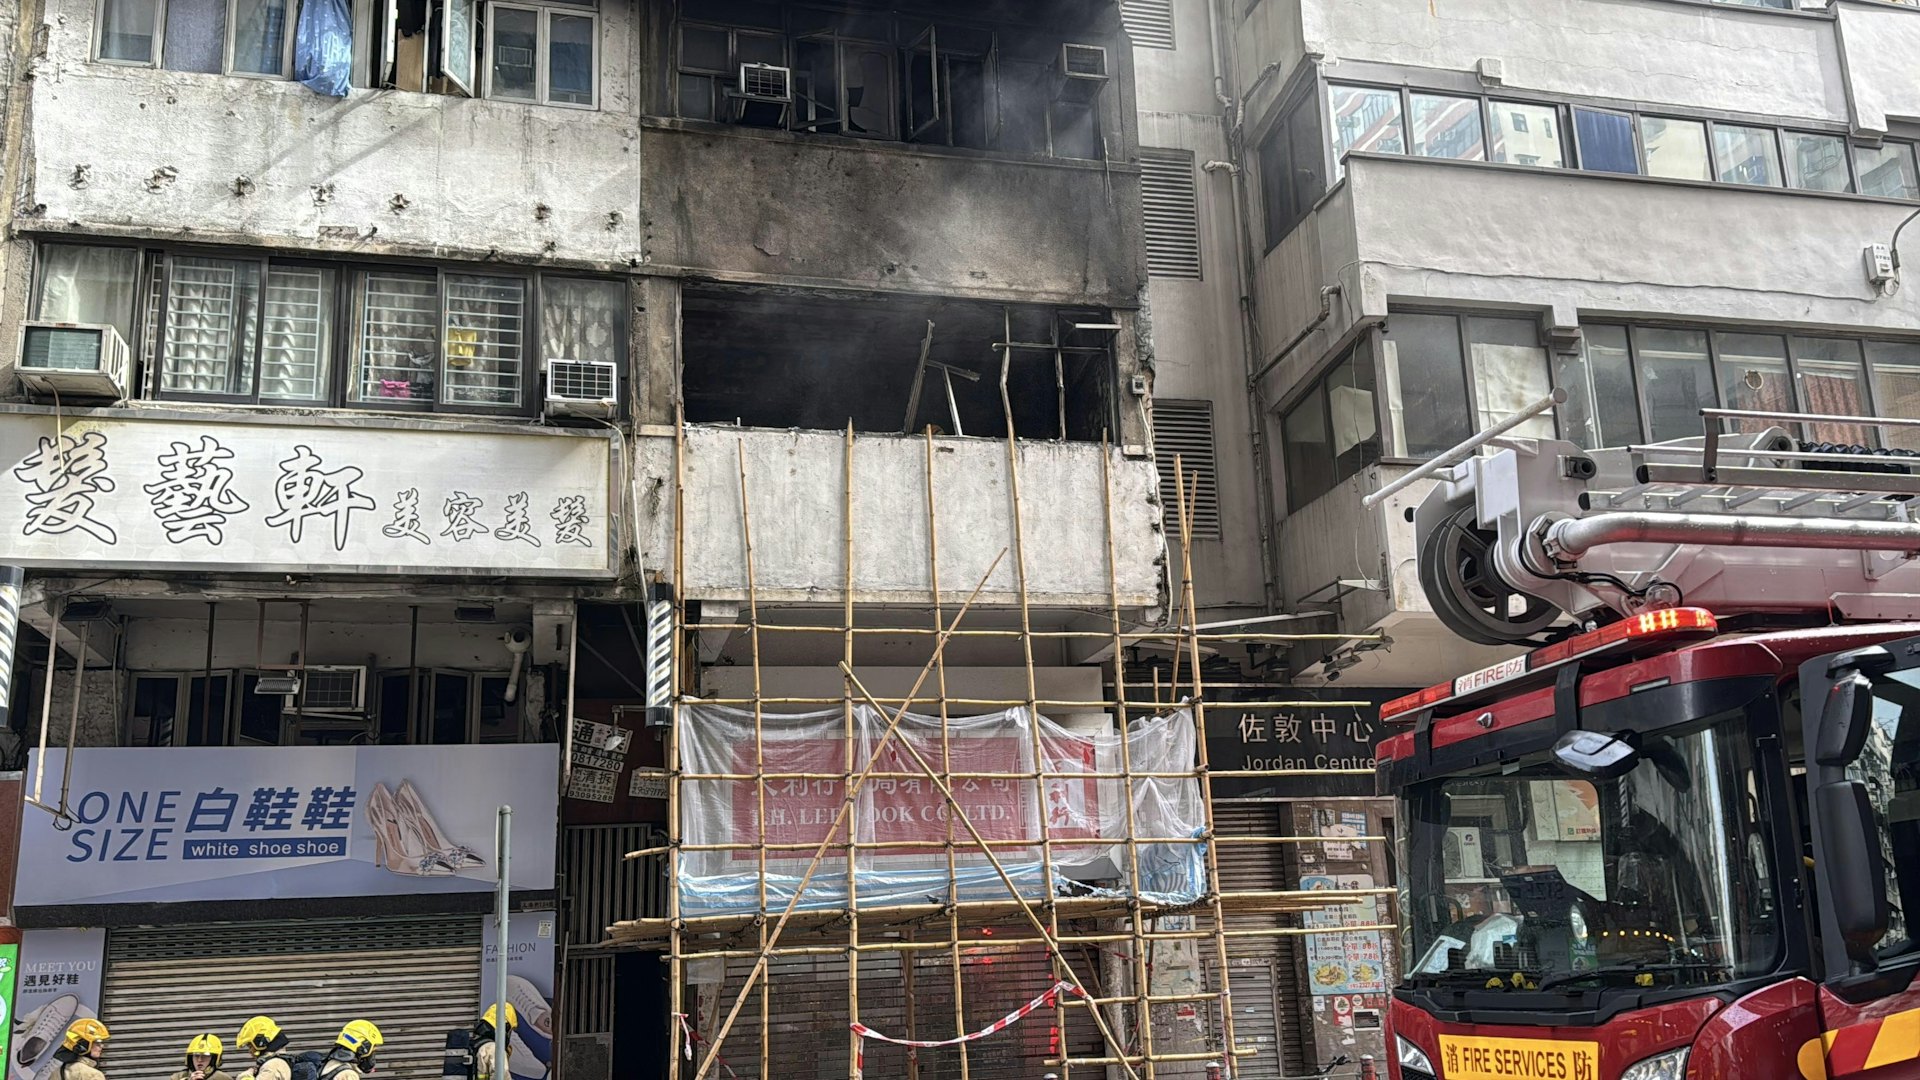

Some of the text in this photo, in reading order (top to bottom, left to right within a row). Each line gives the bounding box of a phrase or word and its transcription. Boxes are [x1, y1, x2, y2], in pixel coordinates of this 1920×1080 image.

[14, 432, 592, 550] 髮藝軒 美容美髮
[1475, 665, 1504, 687] FIRE
[1238, 713, 1373, 743] 佐敦中心
[1242, 754, 1377, 770] Jordan Centre
[78, 791, 181, 824] ONE
[184, 786, 357, 833] 白鞋鞋
[858, 806, 915, 823] OOK
[964, 804, 1010, 821] LTD.
[66, 828, 173, 862] SIZE
[191, 839, 339, 856] white shoe shoe
[485, 943, 537, 955] FAHION
[24, 960, 97, 973] MEET YOU
[23, 974, 79, 987] 遇見好鞋
[1446, 1043, 1592, 1080] 消 FIRE SERVICES 防
